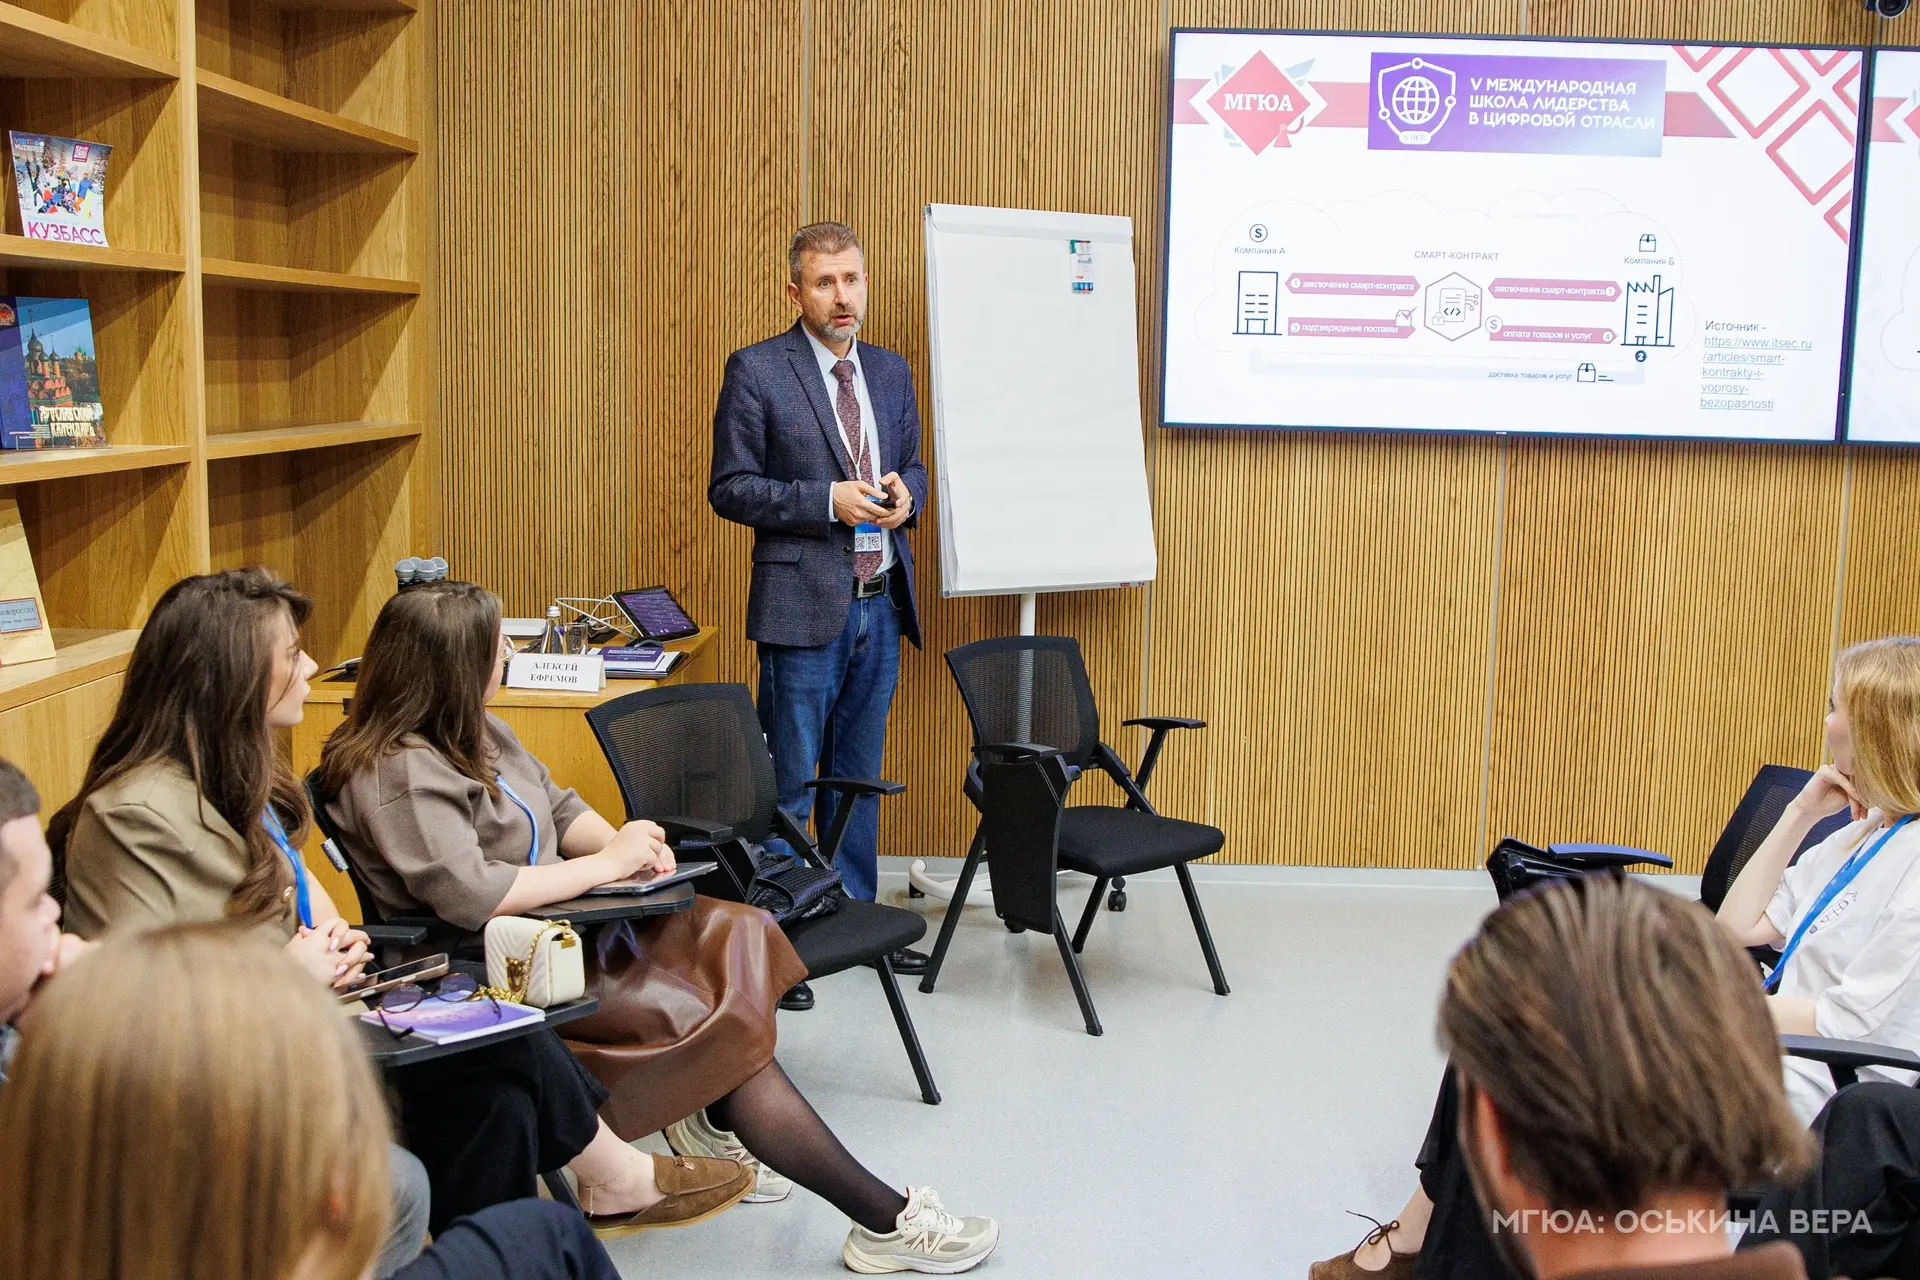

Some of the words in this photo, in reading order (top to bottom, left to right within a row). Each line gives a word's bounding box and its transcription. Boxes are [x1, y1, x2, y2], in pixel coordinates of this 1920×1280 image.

[1470, 77, 1483, 91] V
[1486, 77, 1636, 96] МЕЖДУНАРОДНАЯ
[1224, 93, 1294, 112] МГЮА
[1469, 95, 1529, 109] ШКОЛА
[1533, 97, 1630, 113] ЛИДЕРСТВА
[1468, 111, 1480, 125] В
[1483, 111, 1576, 128] ЦИФРОВОЙ
[1580, 114, 1655, 130] ОТРАСЛИ
[28, 221, 104, 245] КУЗБАСС
[1234, 246, 1277, 255] Компания
[1279, 247, 1286, 255] А
[1414, 250, 1500, 260] СМАРТ-КОНТРАКТ
[1624, 256, 1666, 265] Компания
[1668, 257, 1675, 266] Б
[1302, 281, 1349, 290] заключение
[1350, 282, 1415, 291] смарт-контракта
[1494, 285, 1541, 293] заключение
[1541, 287, 1606, 296] смарт-контракта
[1301, 324, 1362, 334] подтверждение
[1363, 325, 1399, 333] поставки
[1705, 320, 1760, 332] Источник
[1503, 331, 1531, 339] оплата
[1532, 331, 1564, 340] товаров
[1571, 332, 1593, 340] услуг
[1704, 336, 1813, 349] https://www.itsec.ru
[1703, 352, 1786, 363] /articles/smart-
[1488, 371, 1519, 379] доставка
[1702, 366, 1765, 379] kontrakty-i-
[1701, 384, 1749, 395] voprosy-
[1700, 397, 1775, 409] bezopasnosti
[533, 661, 578, 671] АЛЕКСЕЙ
[530, 673, 578, 683] ЕФРЕМОВ
